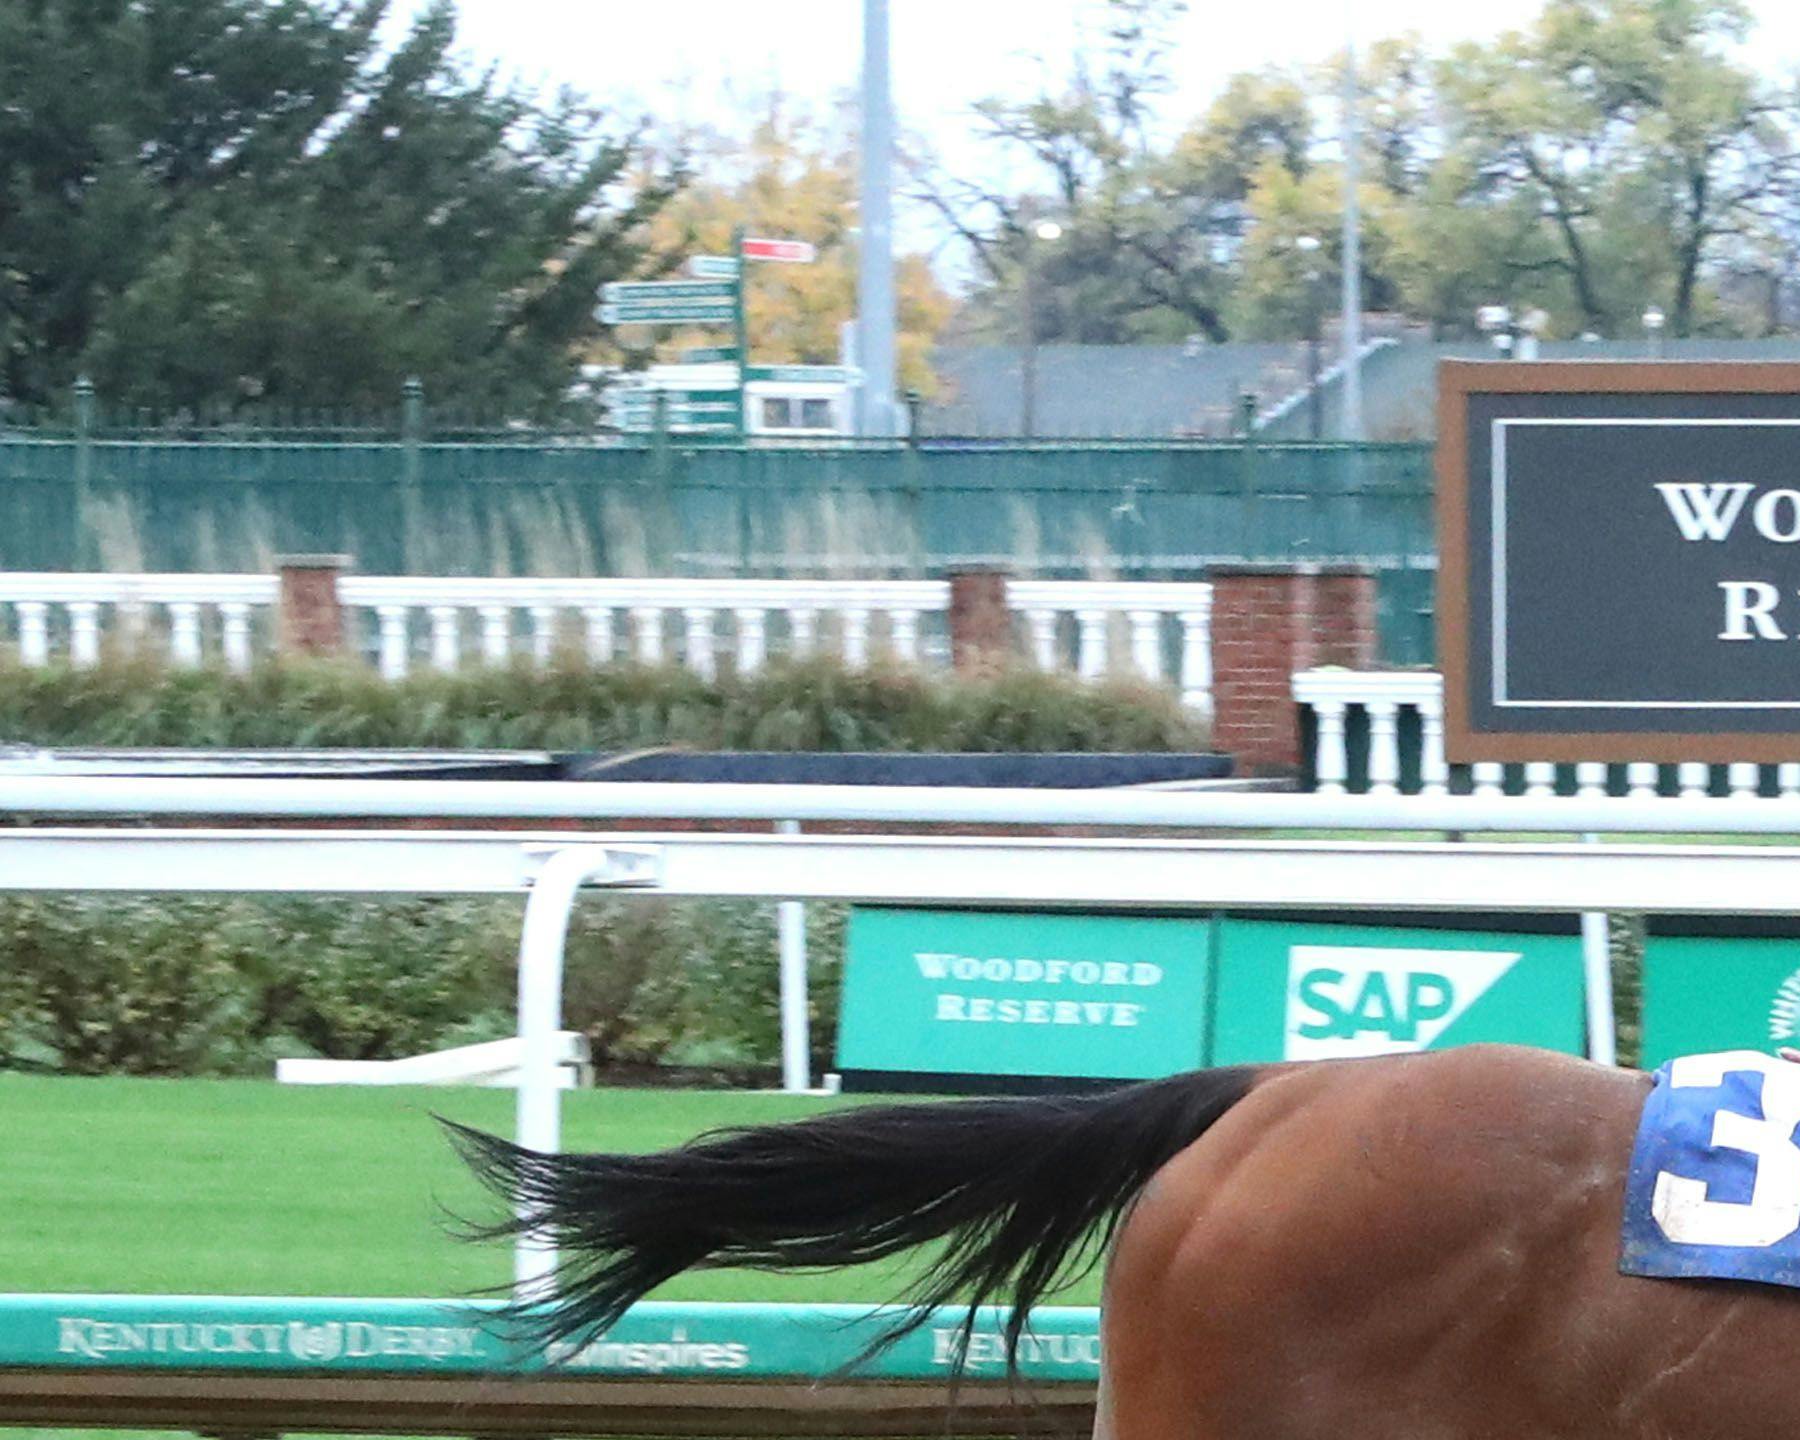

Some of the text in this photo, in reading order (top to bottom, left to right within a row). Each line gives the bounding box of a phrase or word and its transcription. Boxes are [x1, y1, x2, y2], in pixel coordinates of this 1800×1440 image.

[913, 953, 1163, 987] WOODFORD
[1299, 967, 1455, 1042] SAP
[56, 1317, 480, 1362] KENTUCKY DERBY
